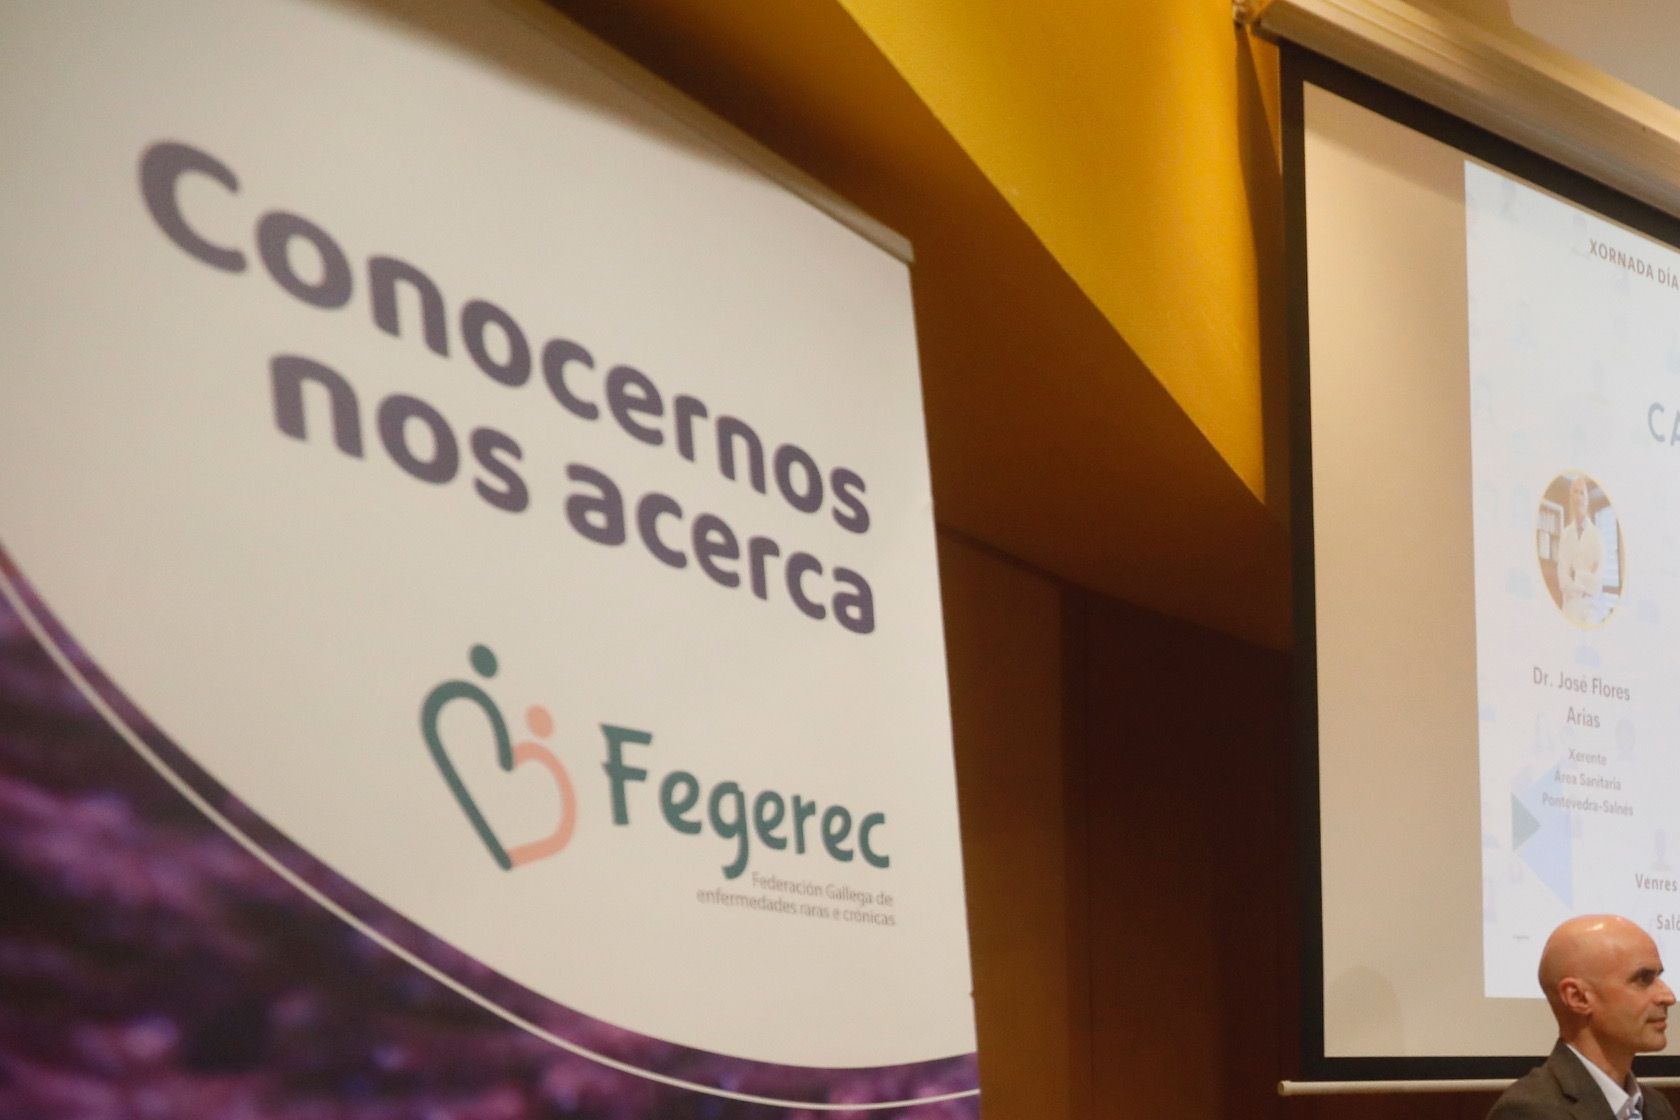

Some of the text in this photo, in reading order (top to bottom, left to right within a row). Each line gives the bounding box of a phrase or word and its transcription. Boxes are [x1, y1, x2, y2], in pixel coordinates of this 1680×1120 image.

[1588, 239, 1654, 280] XORNADA
[1658, 267, 1679, 290] DÍA
[138, 140, 870, 534] Conocernos
[270, 353, 876, 635] nos acerca
[1532, 666, 1553, 688] Dr.
[1592, 678, 1631, 701] Flores
[1567, 706, 1601, 728] Arias
[600, 722, 890, 879] Fegerec
[751, 871, 894, 907] Federación Gallega de
[1635, 873, 1678, 892] Venres
[696, 887, 797, 915] enfermedades
[800, 903, 830, 919] raras
[843, 908, 897, 926] crónicas
